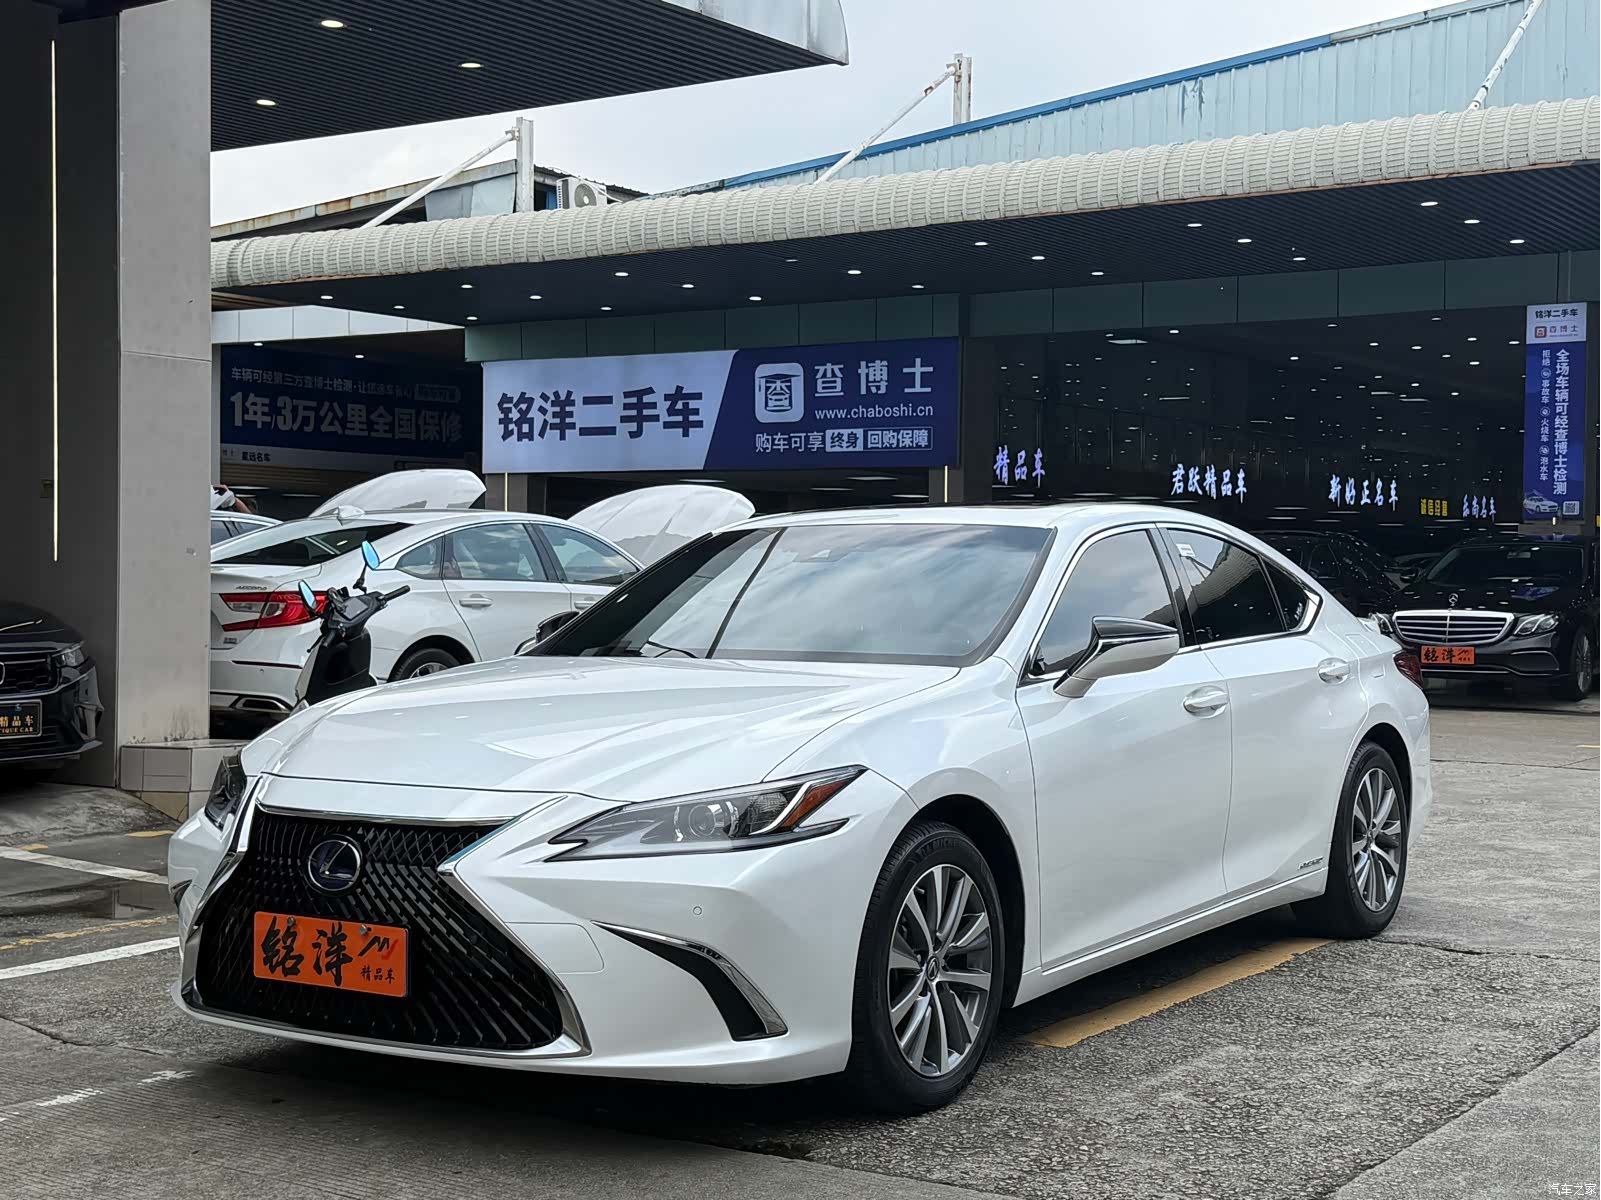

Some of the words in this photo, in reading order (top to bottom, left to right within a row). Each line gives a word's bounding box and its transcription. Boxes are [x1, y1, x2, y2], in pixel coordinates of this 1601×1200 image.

[1535, 308, 1579, 319] 铭洋二手车
[814, 358, 934, 397] 查博士
[497, 385, 704, 442] 铭洋二手车
[815, 404, 934, 419] www.chaboshi.cn
[1553, 349, 1570, 495] 全场车辆可经查博士检测
[755, 431, 824, 453] 购车可享
[829, 431, 860, 449] 终身
[867, 429, 929, 448] 回购保障
[993, 445, 1045, 488] 精品车
[1171, 463, 1247, 503] 君跃精品车
[261, 916, 354, 987] 铭洋
[360, 966, 396, 984] 精品车
